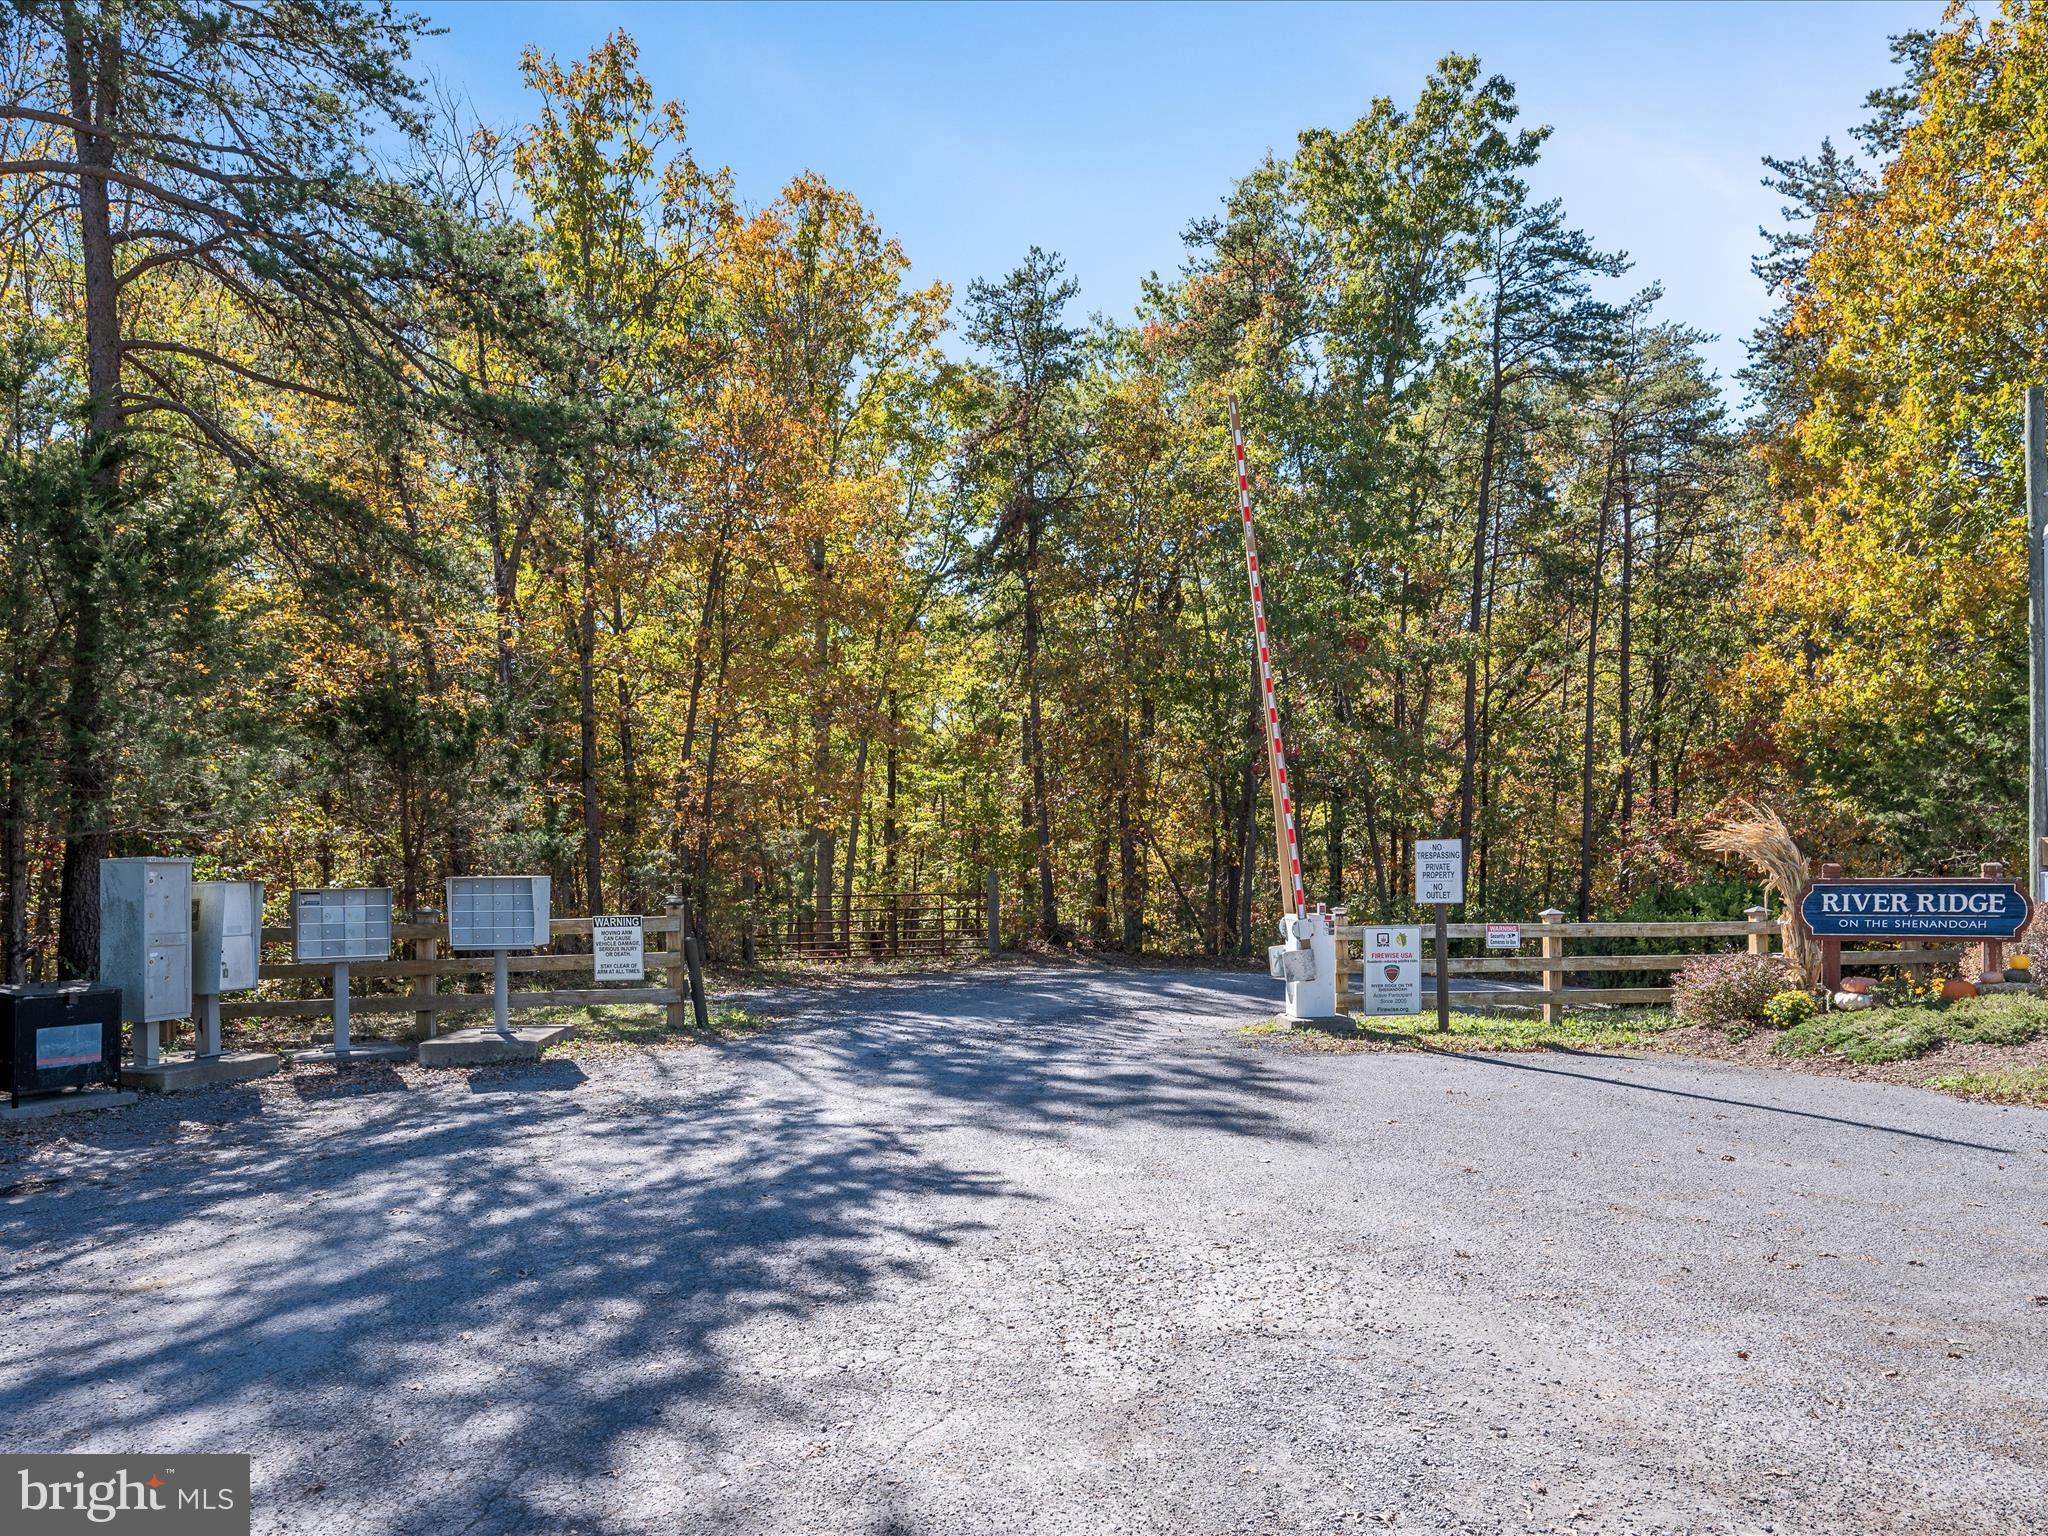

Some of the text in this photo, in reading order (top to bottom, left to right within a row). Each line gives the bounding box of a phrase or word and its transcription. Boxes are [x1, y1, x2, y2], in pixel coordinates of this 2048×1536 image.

[1417, 852, 1460, 860] TRESPASSING
[1821, 894, 2006, 913] RIVER RIDGE
[595, 918, 639, 927] WARNING
[1839, 919, 1987, 929] ON THE SHENANDOAH
